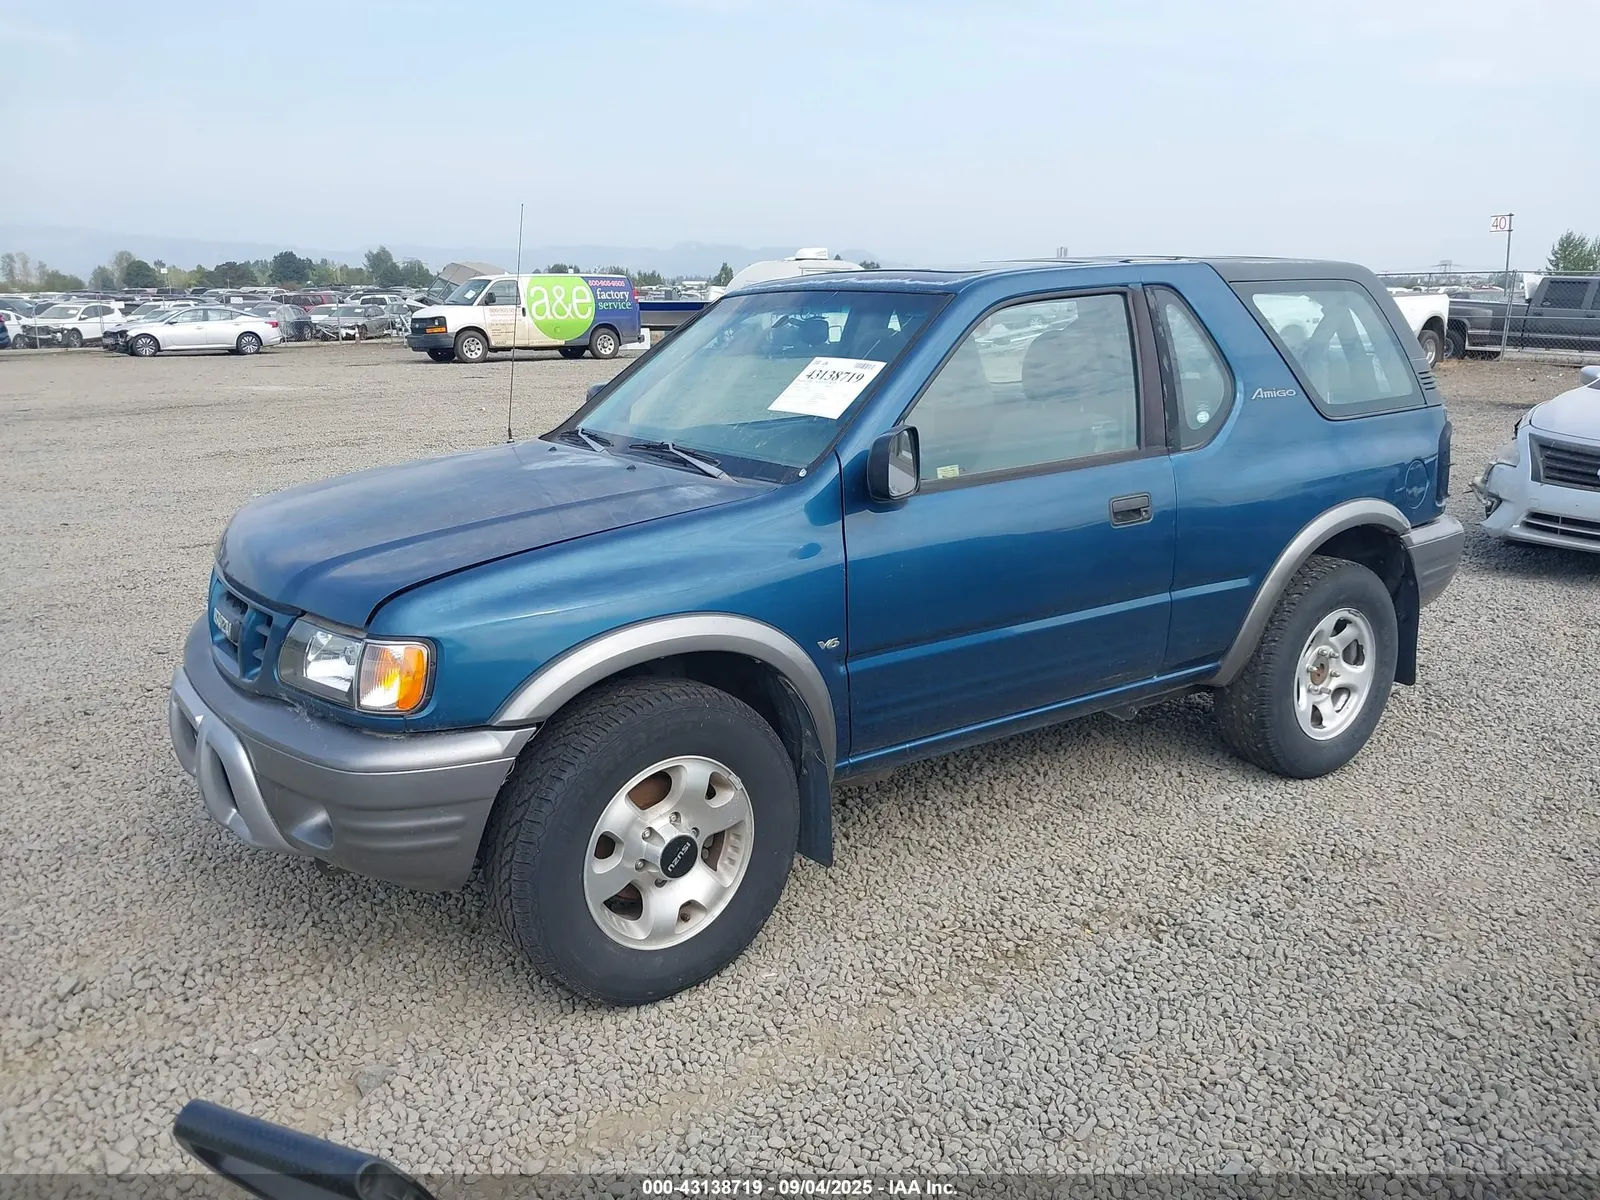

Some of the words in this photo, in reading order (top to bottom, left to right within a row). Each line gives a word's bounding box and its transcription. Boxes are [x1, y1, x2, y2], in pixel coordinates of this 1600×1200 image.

[1491, 216, 1507, 230] 40
[597, 288, 630, 302] factory
[530, 285, 592, 320] a&e
[598, 299, 632, 310] service
[806, 369, 865, 383] 43138719
[816, 637, 840, 650] V6
[667, 841, 691, 872] ISUZU
